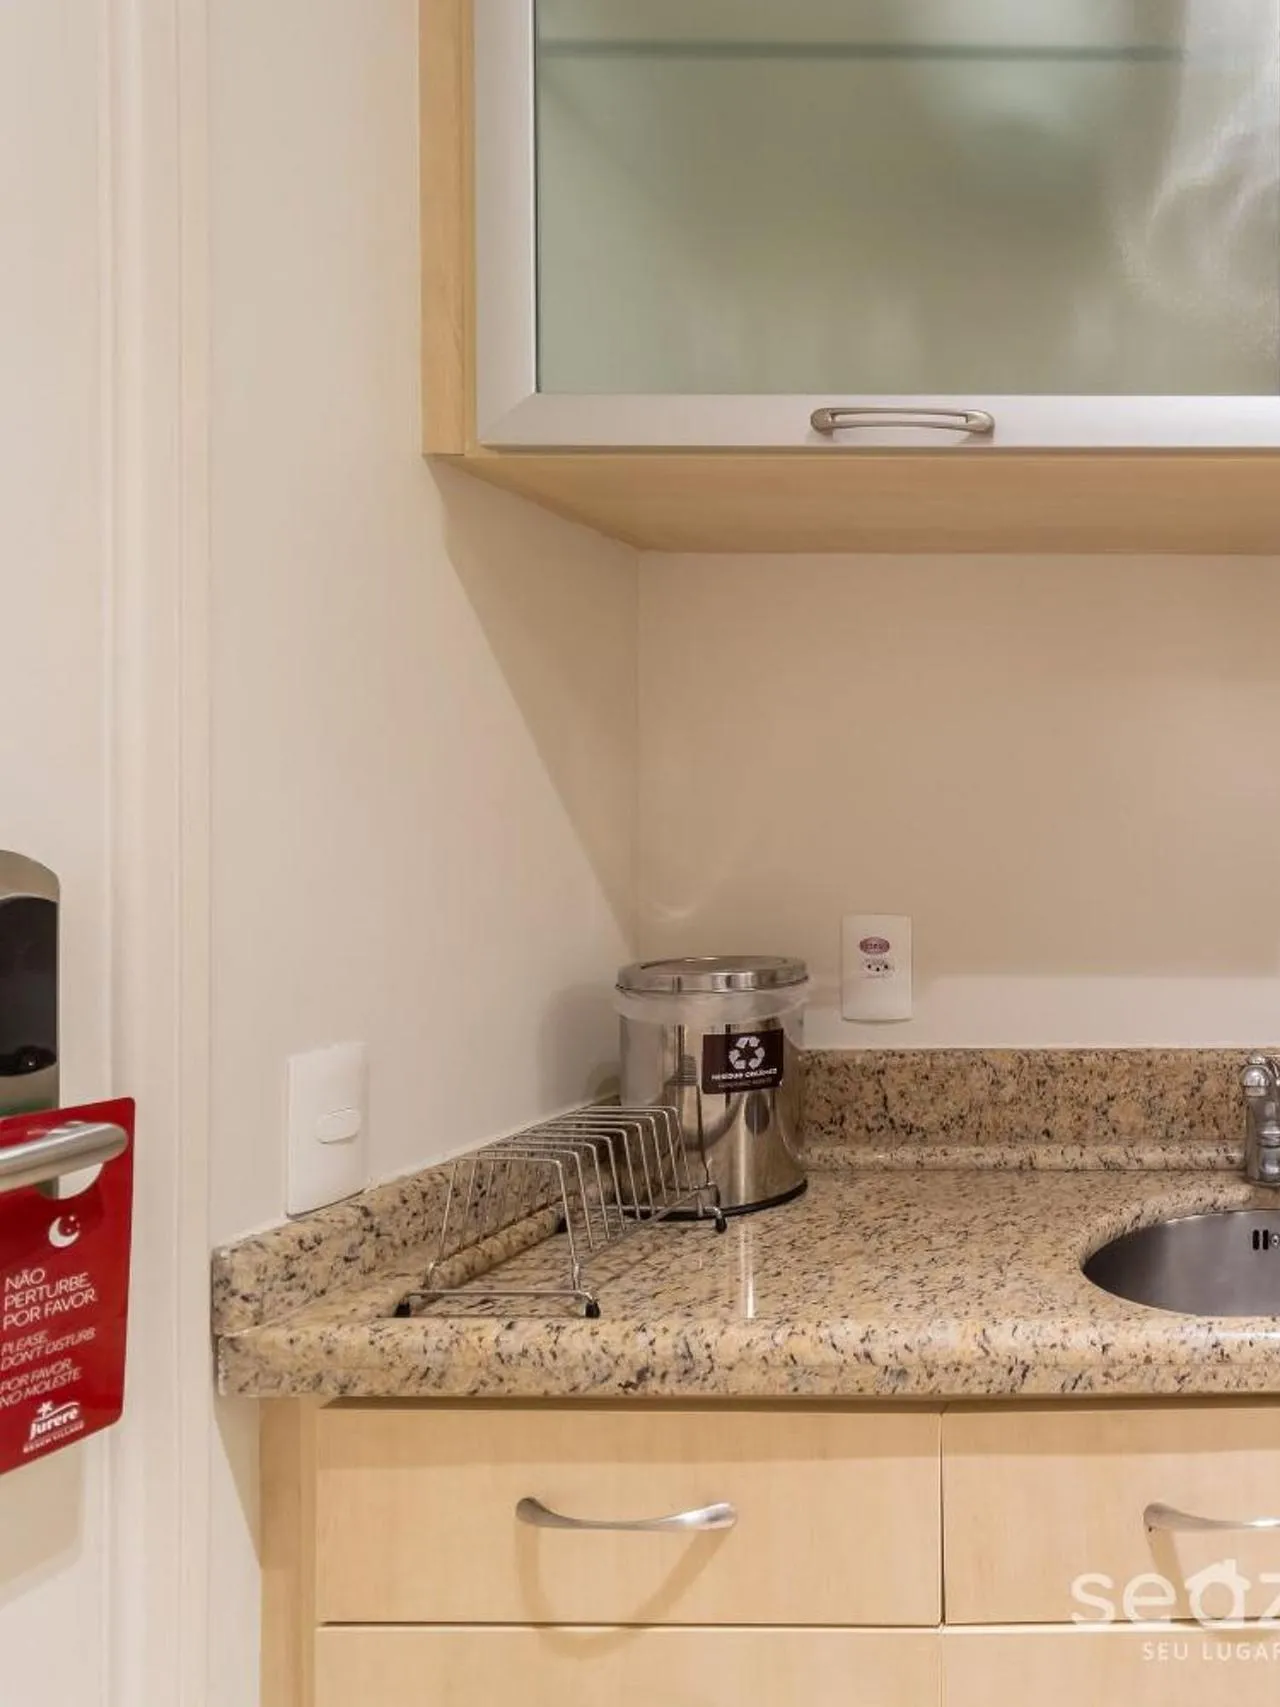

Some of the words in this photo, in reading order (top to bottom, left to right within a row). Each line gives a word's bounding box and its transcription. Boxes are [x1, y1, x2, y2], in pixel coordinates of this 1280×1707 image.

[5, 1268, 46, 1292] NÃO
[5, 1272, 92, 1312] PERTURBE
[3, 1306, 41, 1331] POR
[44, 1288, 98, 1319] FAVOR
